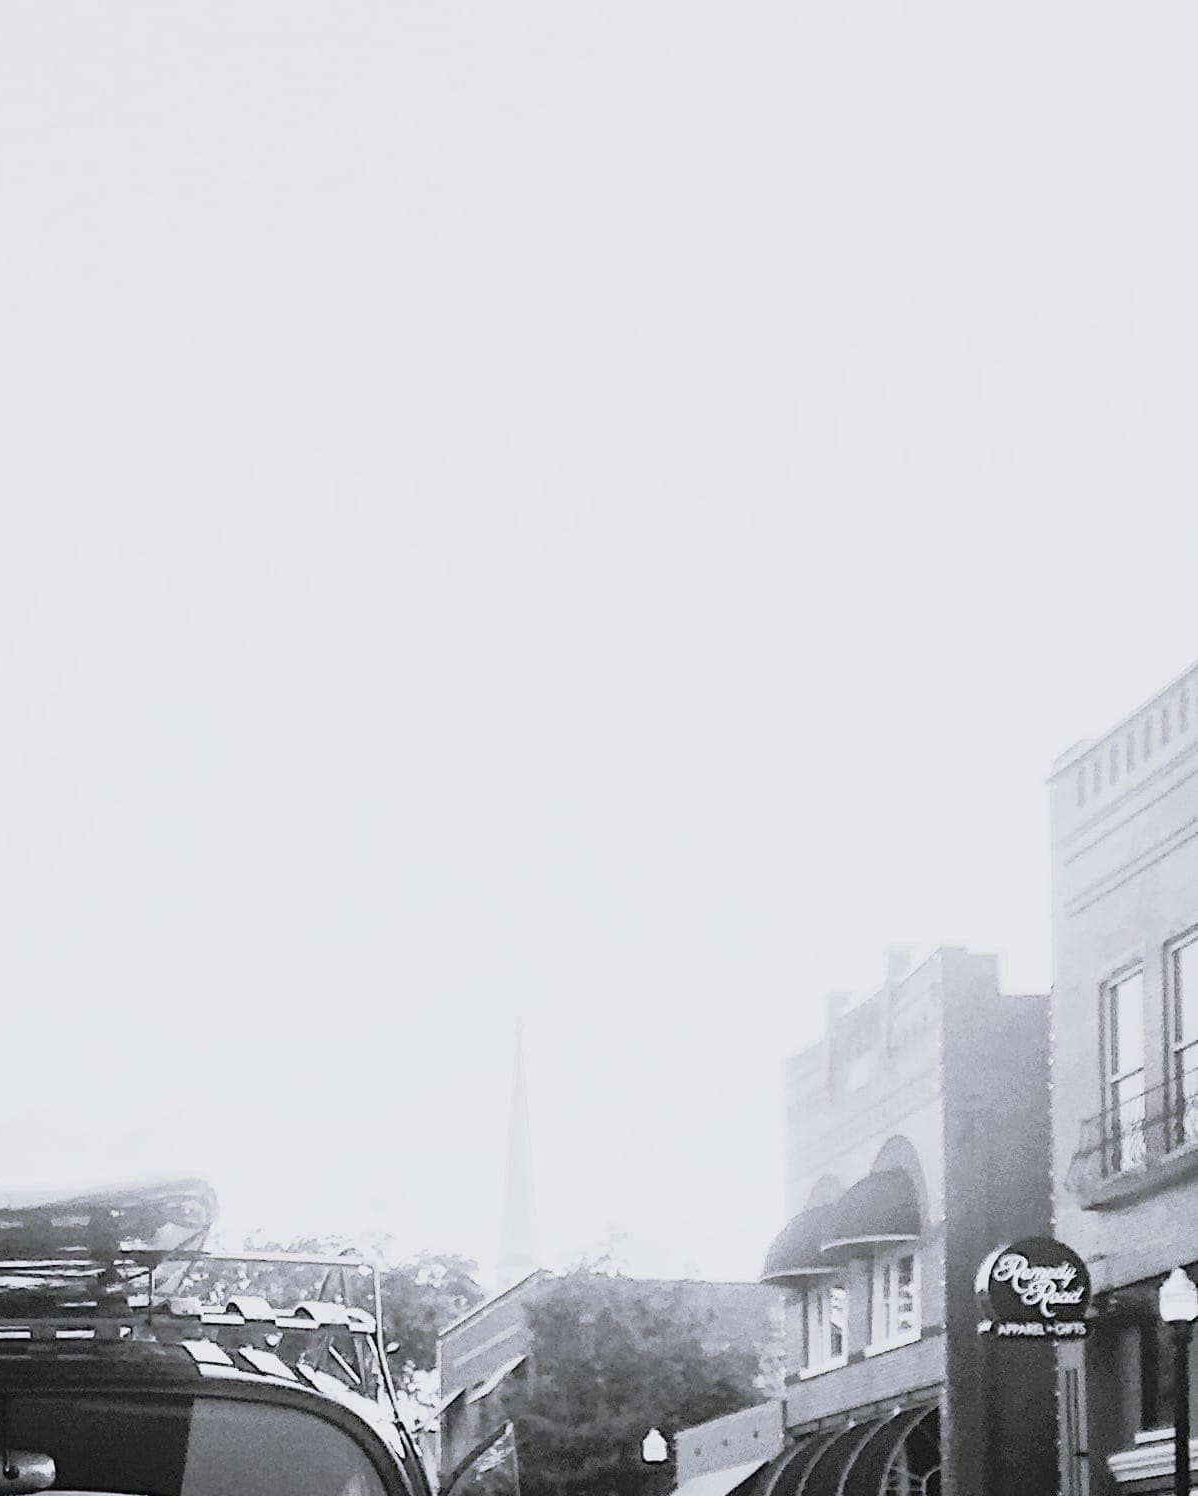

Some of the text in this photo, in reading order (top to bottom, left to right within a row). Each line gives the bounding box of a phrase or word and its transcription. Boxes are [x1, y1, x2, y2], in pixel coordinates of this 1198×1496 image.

[993, 1253, 1077, 1293] Remedy
[1021, 1279, 1085, 1318] Road
[998, 1321, 1046, 1336] APPAREL
[1055, 1320, 1087, 1336] GIFTS
